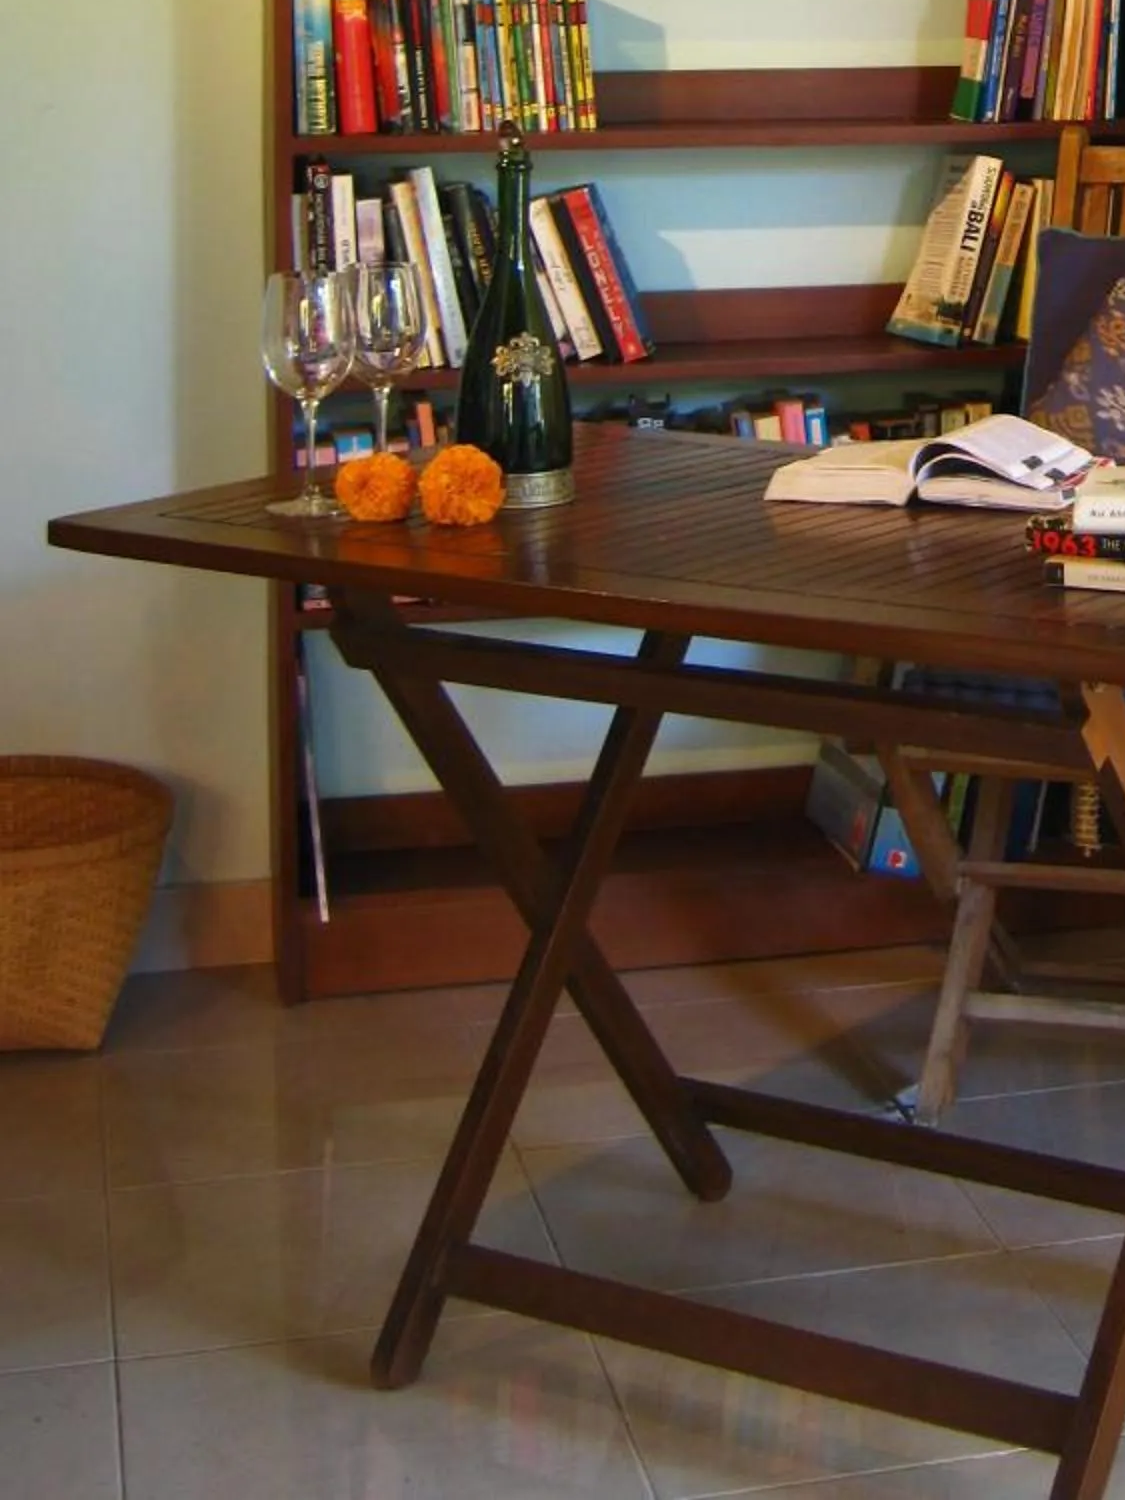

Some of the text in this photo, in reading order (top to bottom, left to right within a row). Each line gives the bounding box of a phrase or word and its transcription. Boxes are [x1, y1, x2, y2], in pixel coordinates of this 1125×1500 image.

[960, 209, 985, 253] BALI
[1032, 529, 1097, 558] 1963
[1102, 538, 1121, 551] THE
